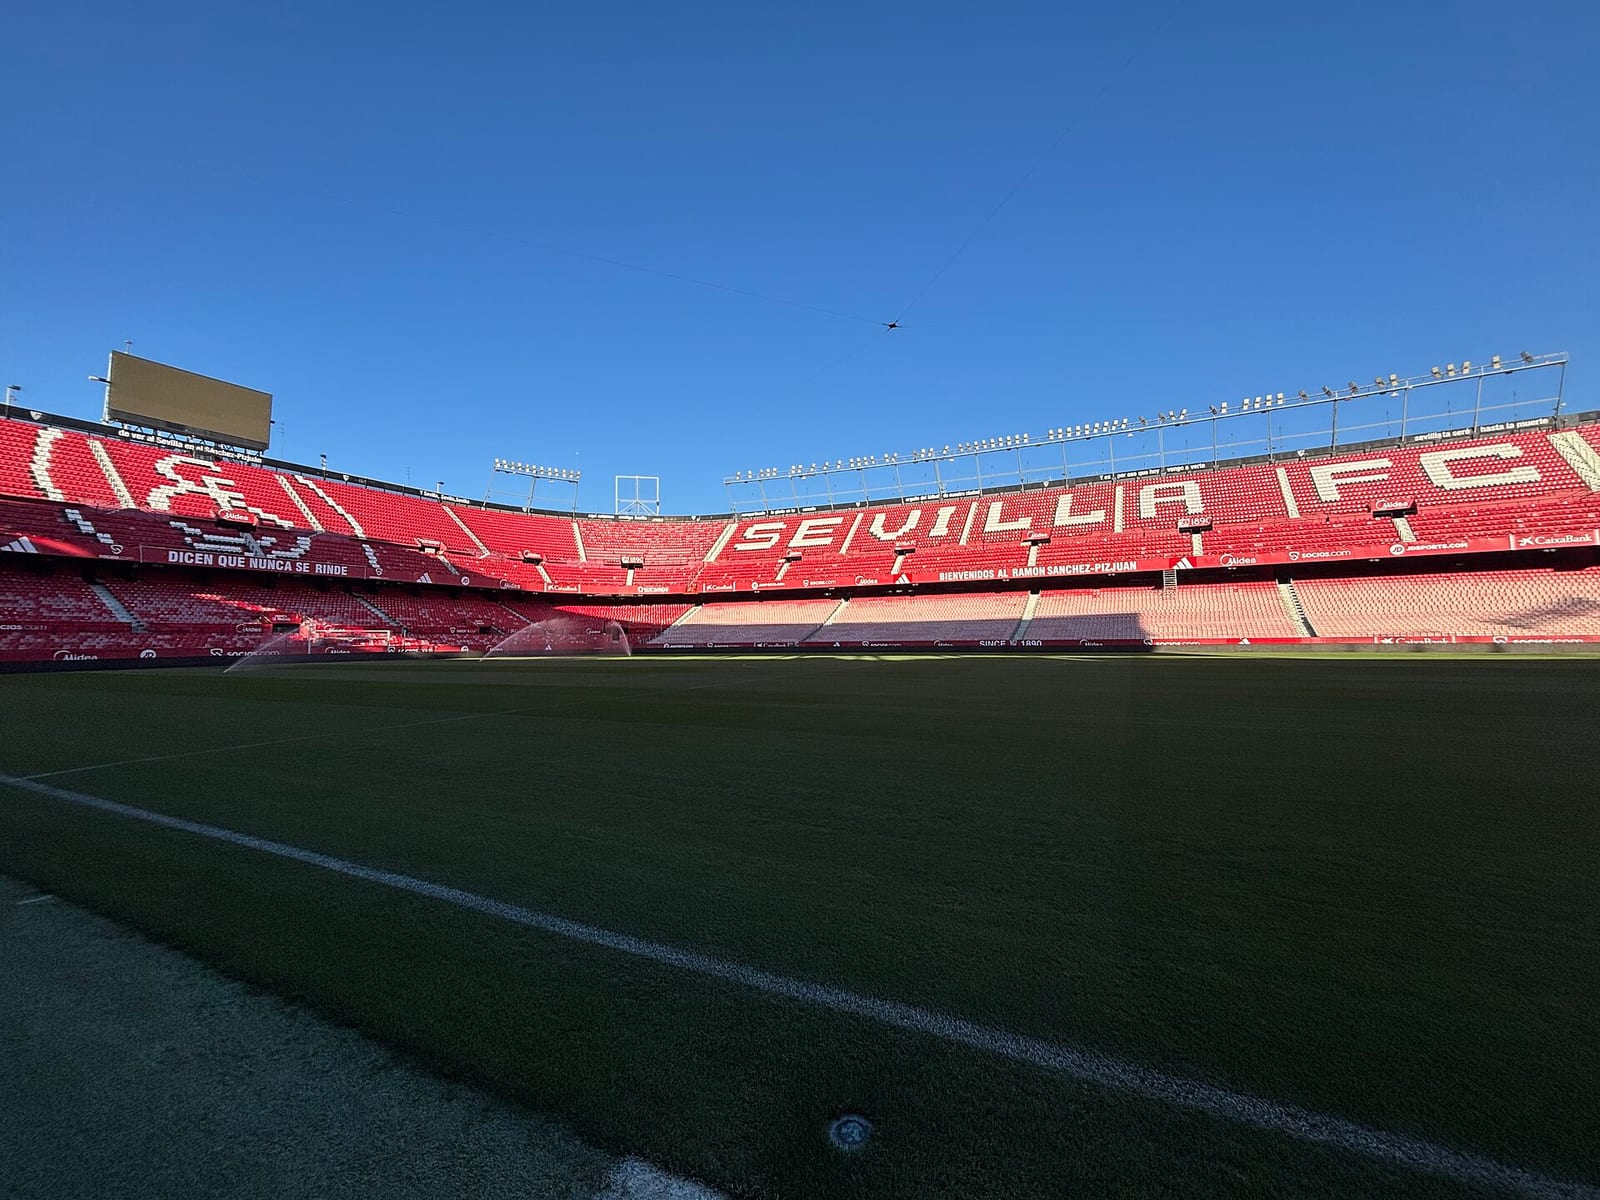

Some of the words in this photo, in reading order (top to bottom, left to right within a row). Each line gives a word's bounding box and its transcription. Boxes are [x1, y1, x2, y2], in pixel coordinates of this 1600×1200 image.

[156, 437, 184, 448] Sevilla
[1310, 443, 1541, 503] FC
[733, 481, 1205, 551] SEVILLA
[1534, 534, 1592, 545] CaixaBank
[168, 551, 213, 565] DICEN
[218, 555, 246, 568] QUE
[250, 557, 292, 571] NUNCA
[295, 561, 310, 573] SE
[315, 564, 348, 576] RINDE
[1301, 550, 1351, 558] socios.com
[939, 569, 995, 581] BIENVENIDOS
[997, 568, 1009, 578] AL
[1012, 566, 1046, 577] RAMON
[1047, 561, 1137, 575] SANCHEZ-PIZJUAN
